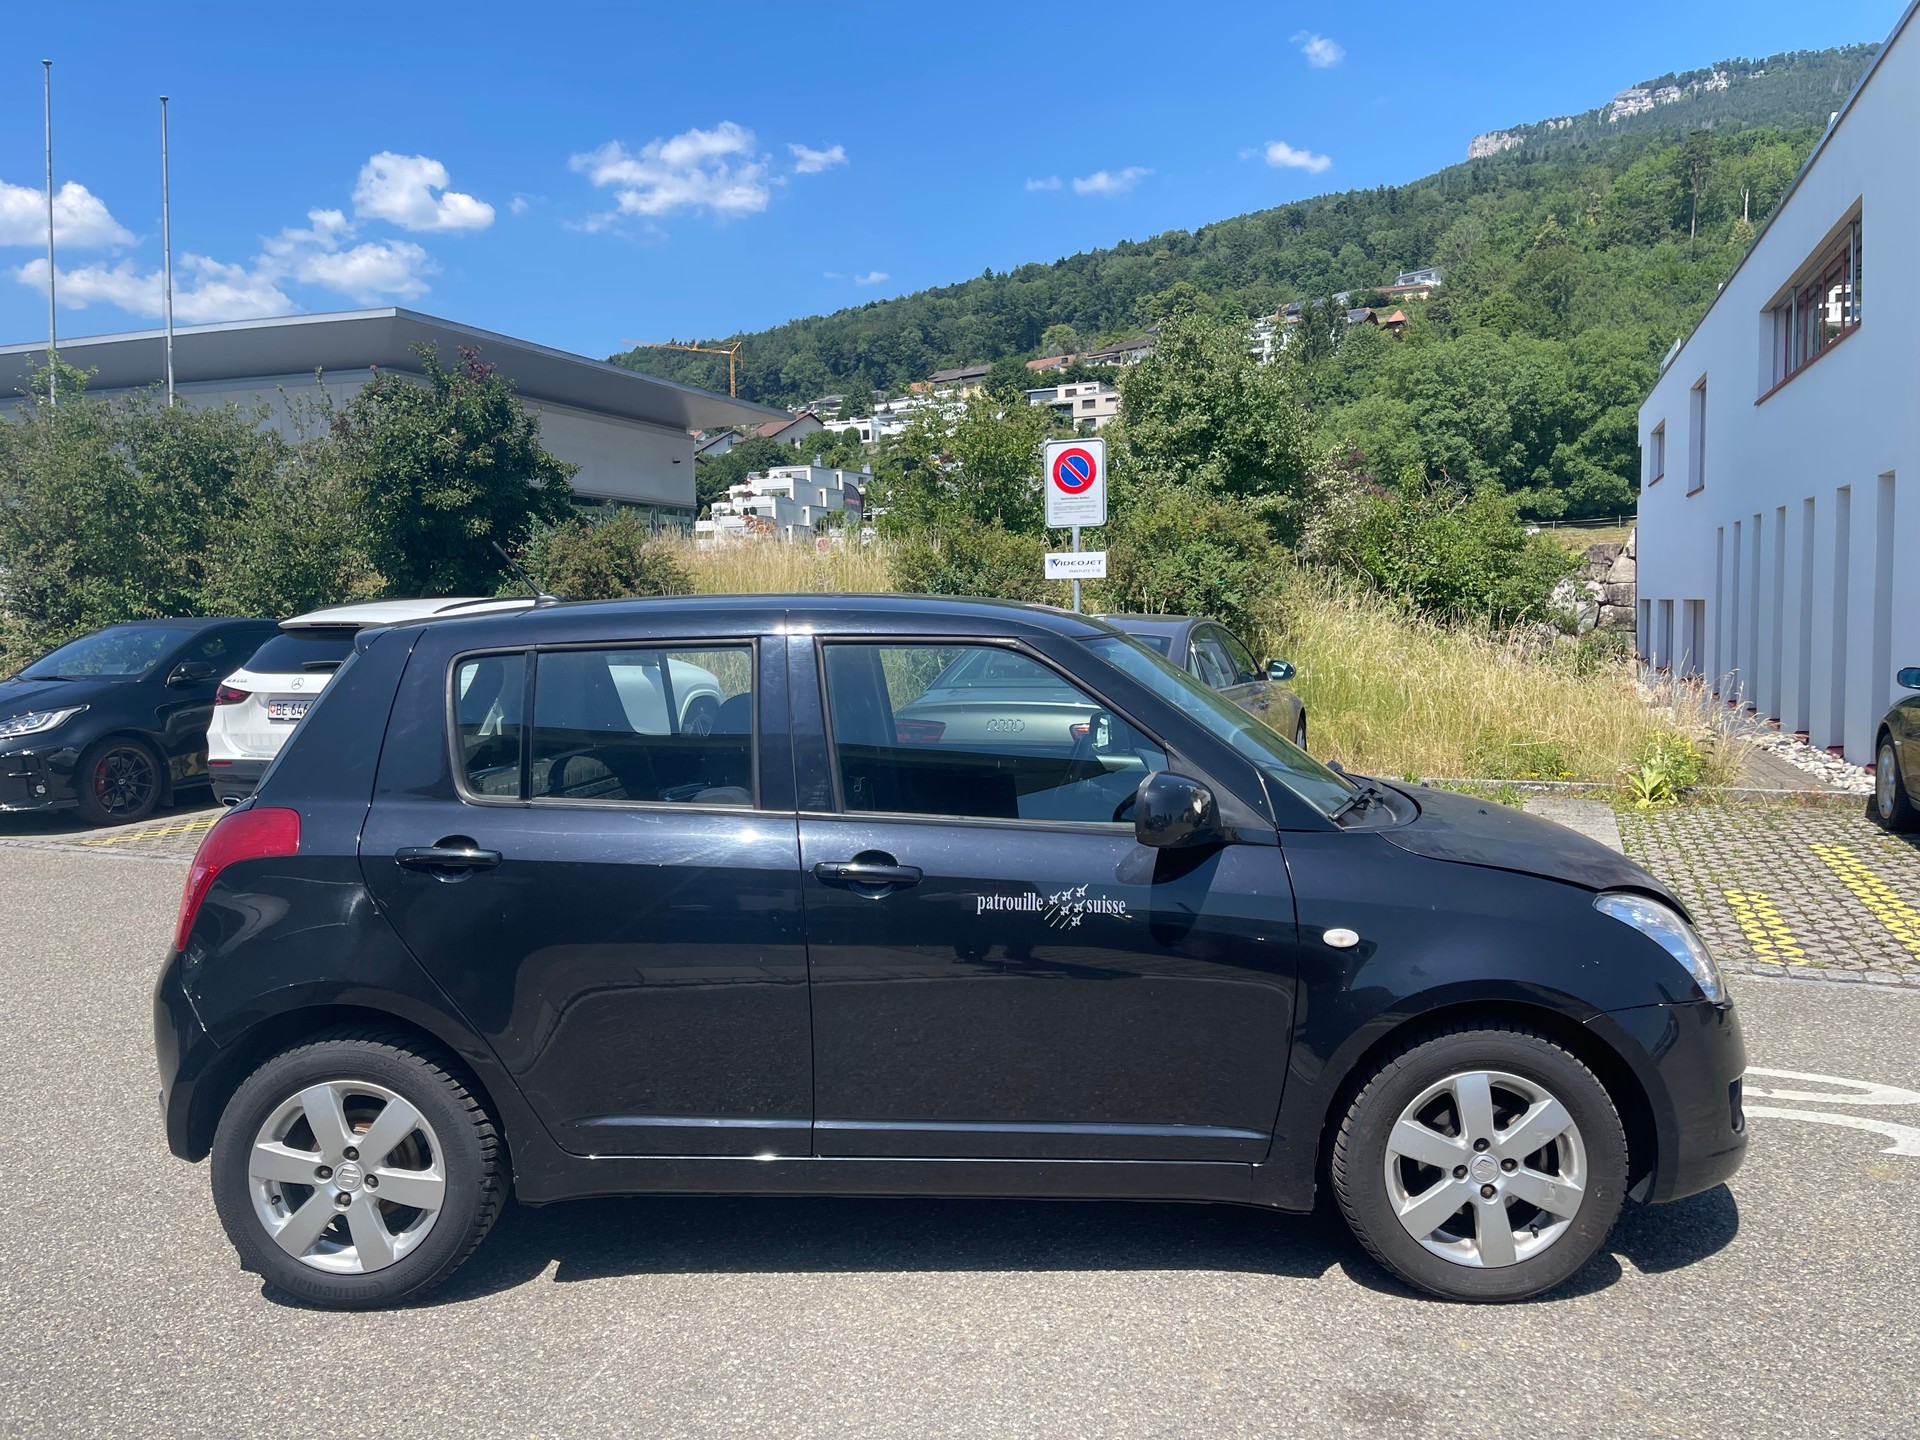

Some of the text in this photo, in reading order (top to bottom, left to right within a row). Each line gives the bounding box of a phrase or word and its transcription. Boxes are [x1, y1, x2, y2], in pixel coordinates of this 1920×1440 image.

[1049, 558, 1103, 568] VIDEOJET
[976, 892, 1126, 915] patrouille suisse
